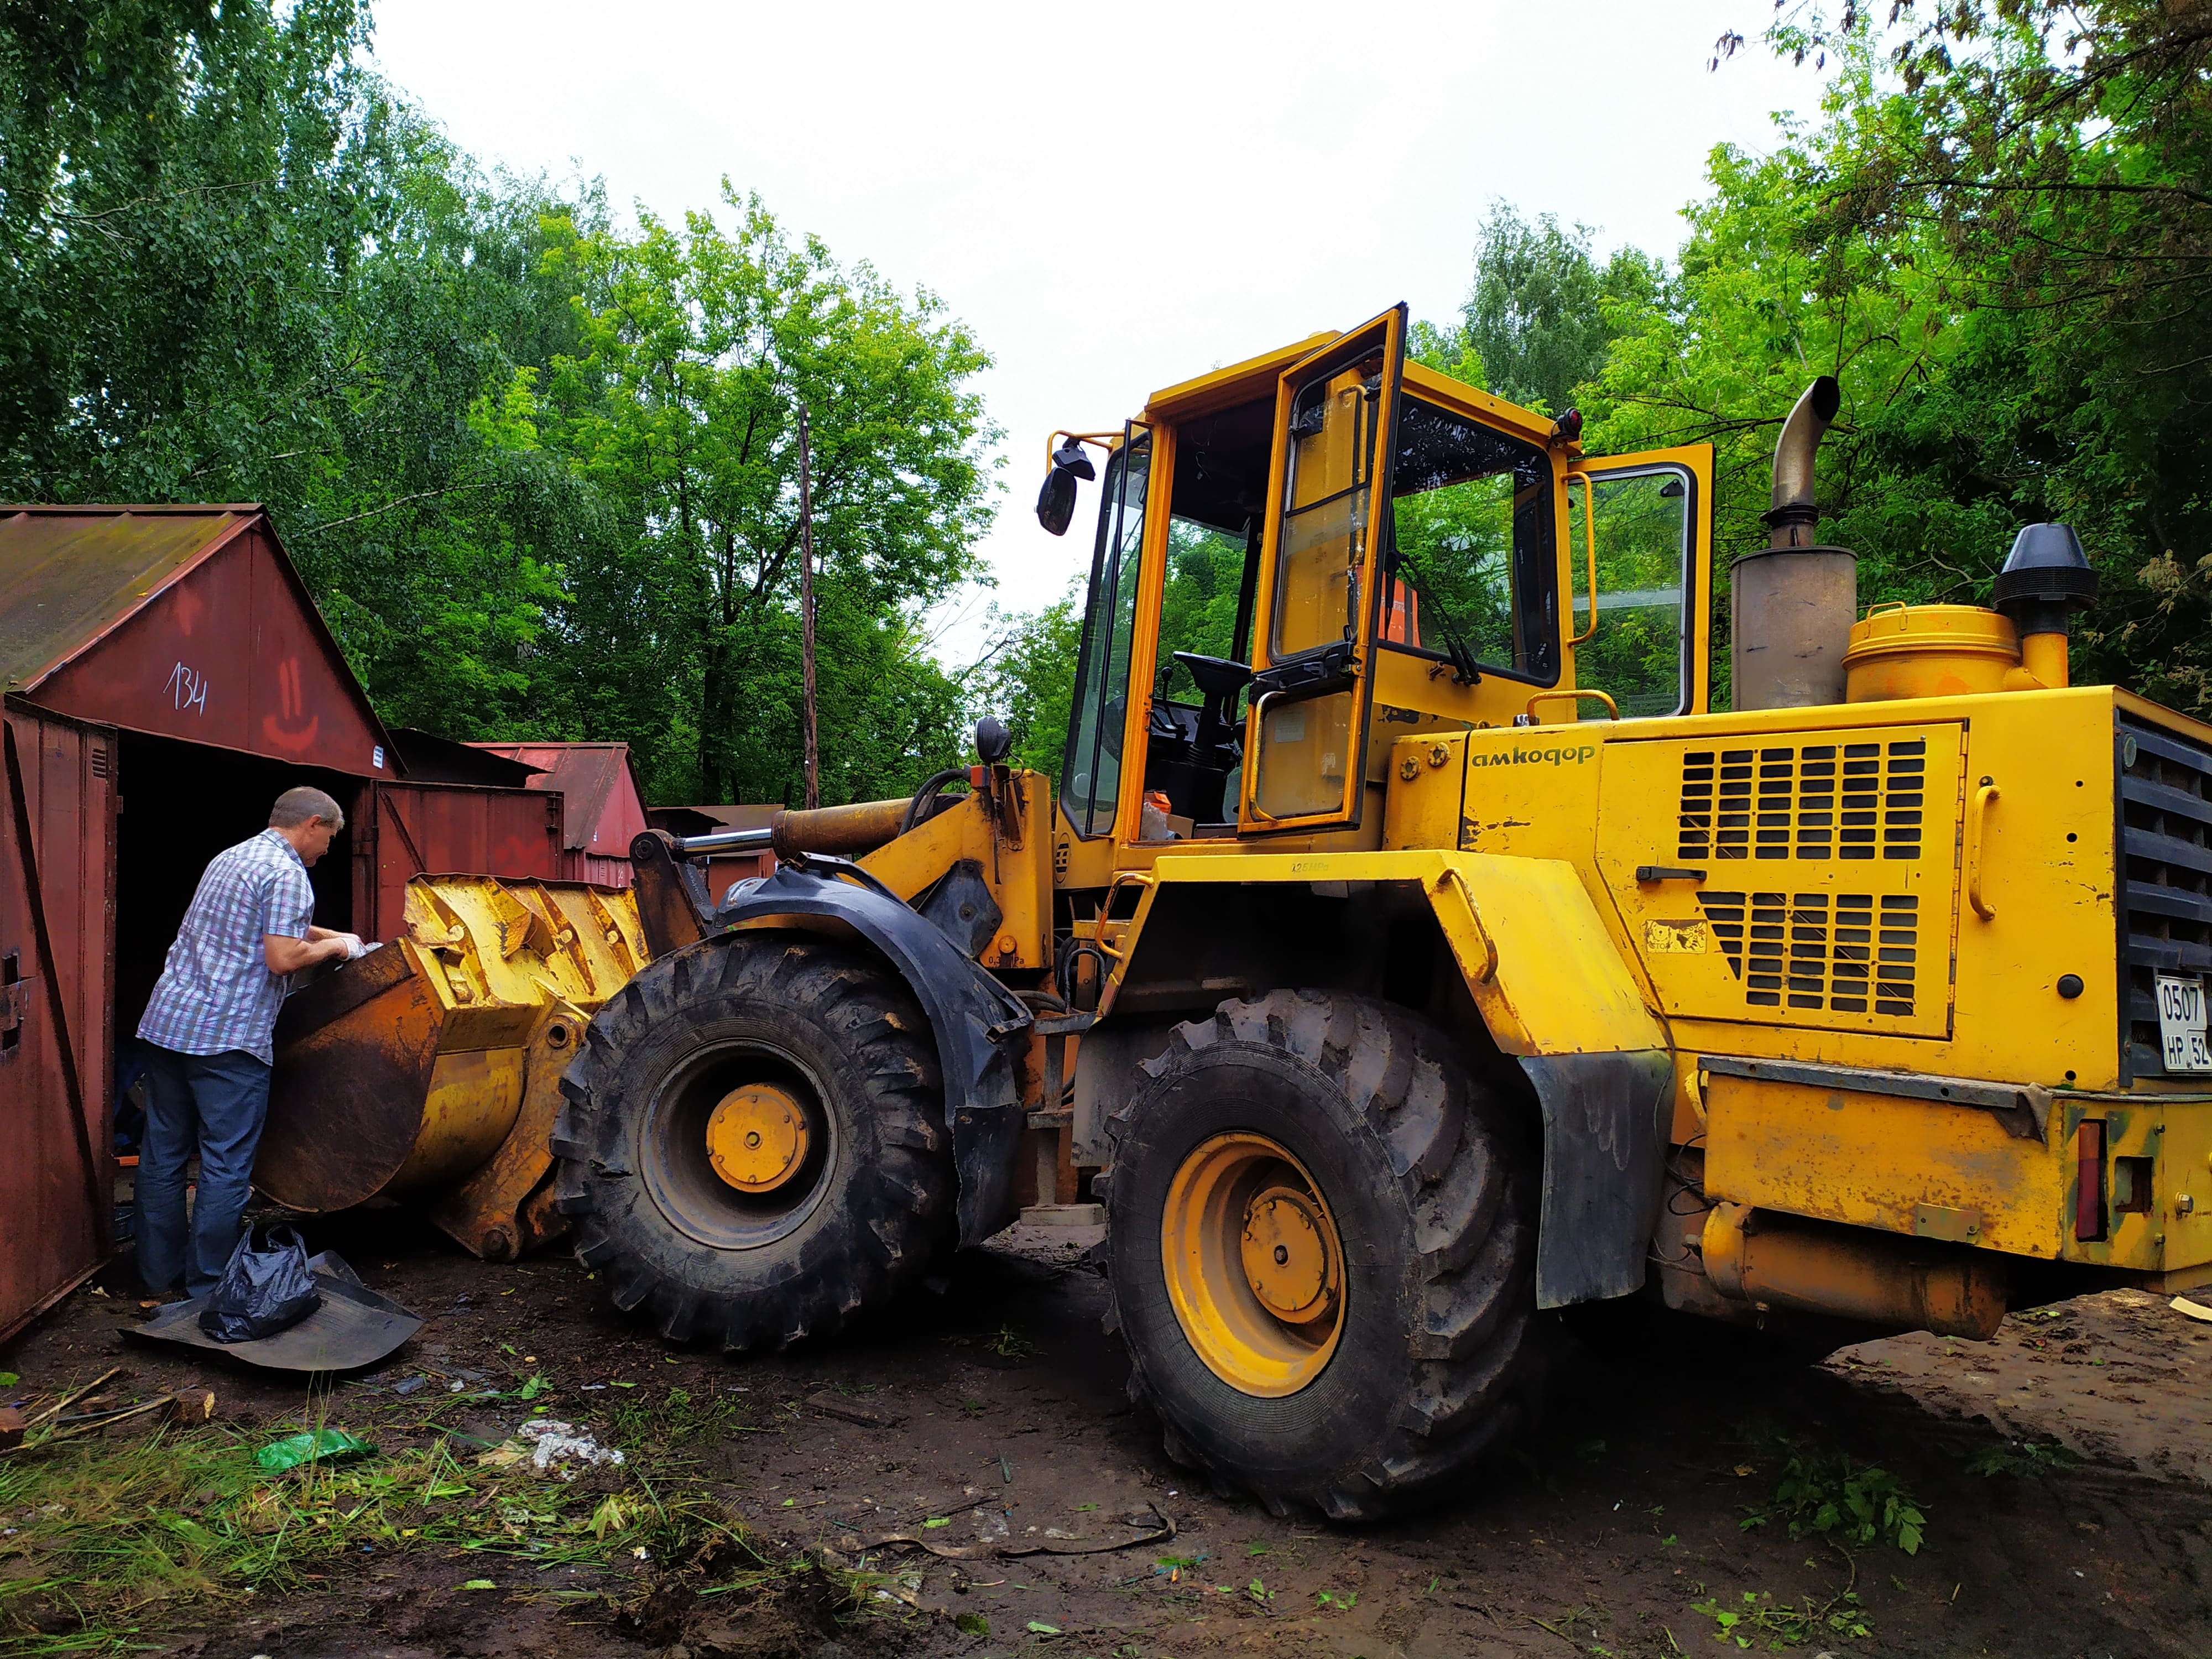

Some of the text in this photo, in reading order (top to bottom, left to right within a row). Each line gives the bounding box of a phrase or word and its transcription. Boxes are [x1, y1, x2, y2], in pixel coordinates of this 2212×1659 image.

[163, 660, 208, 717] 134
[2164, 984, 2198, 1021] 0507
[2191, 1037, 2209, 1065] 52
